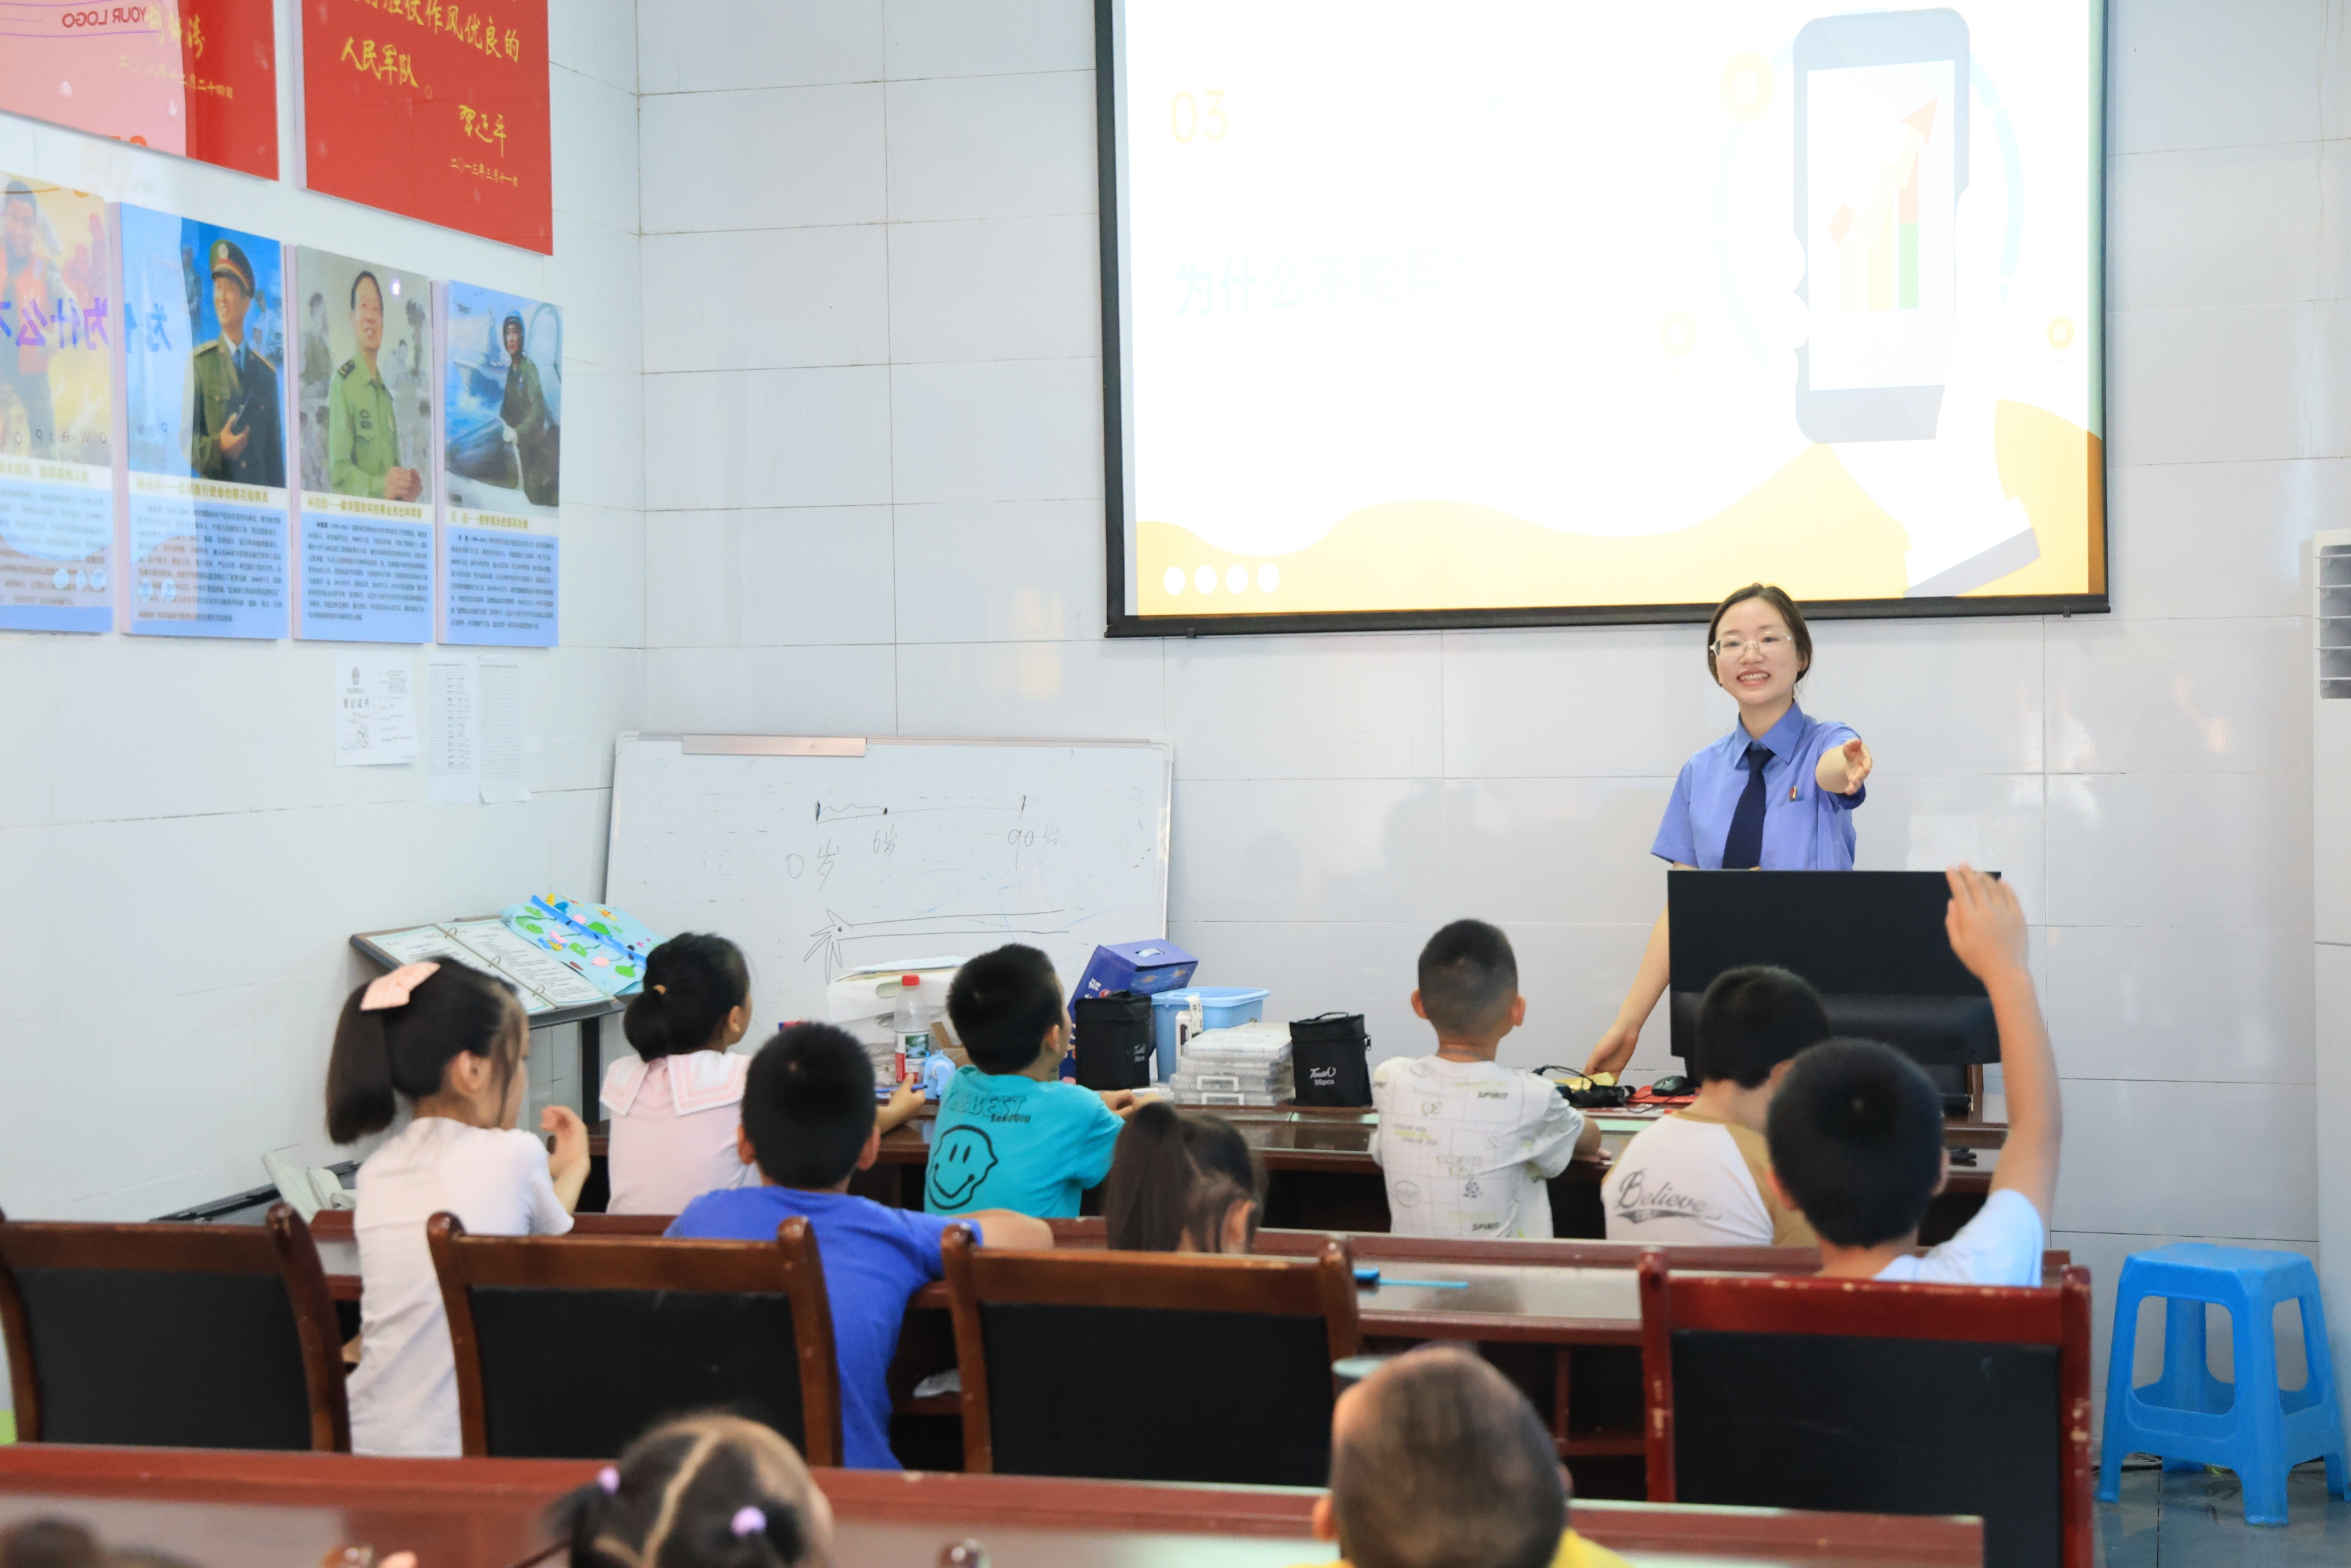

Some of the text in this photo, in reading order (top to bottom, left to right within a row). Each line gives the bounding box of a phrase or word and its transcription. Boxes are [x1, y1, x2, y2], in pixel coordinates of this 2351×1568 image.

[1171, 88, 1228, 143] 03
[1615, 1168, 1708, 1212] Believe
[1472, 1222, 1500, 1231] SPIRIT
